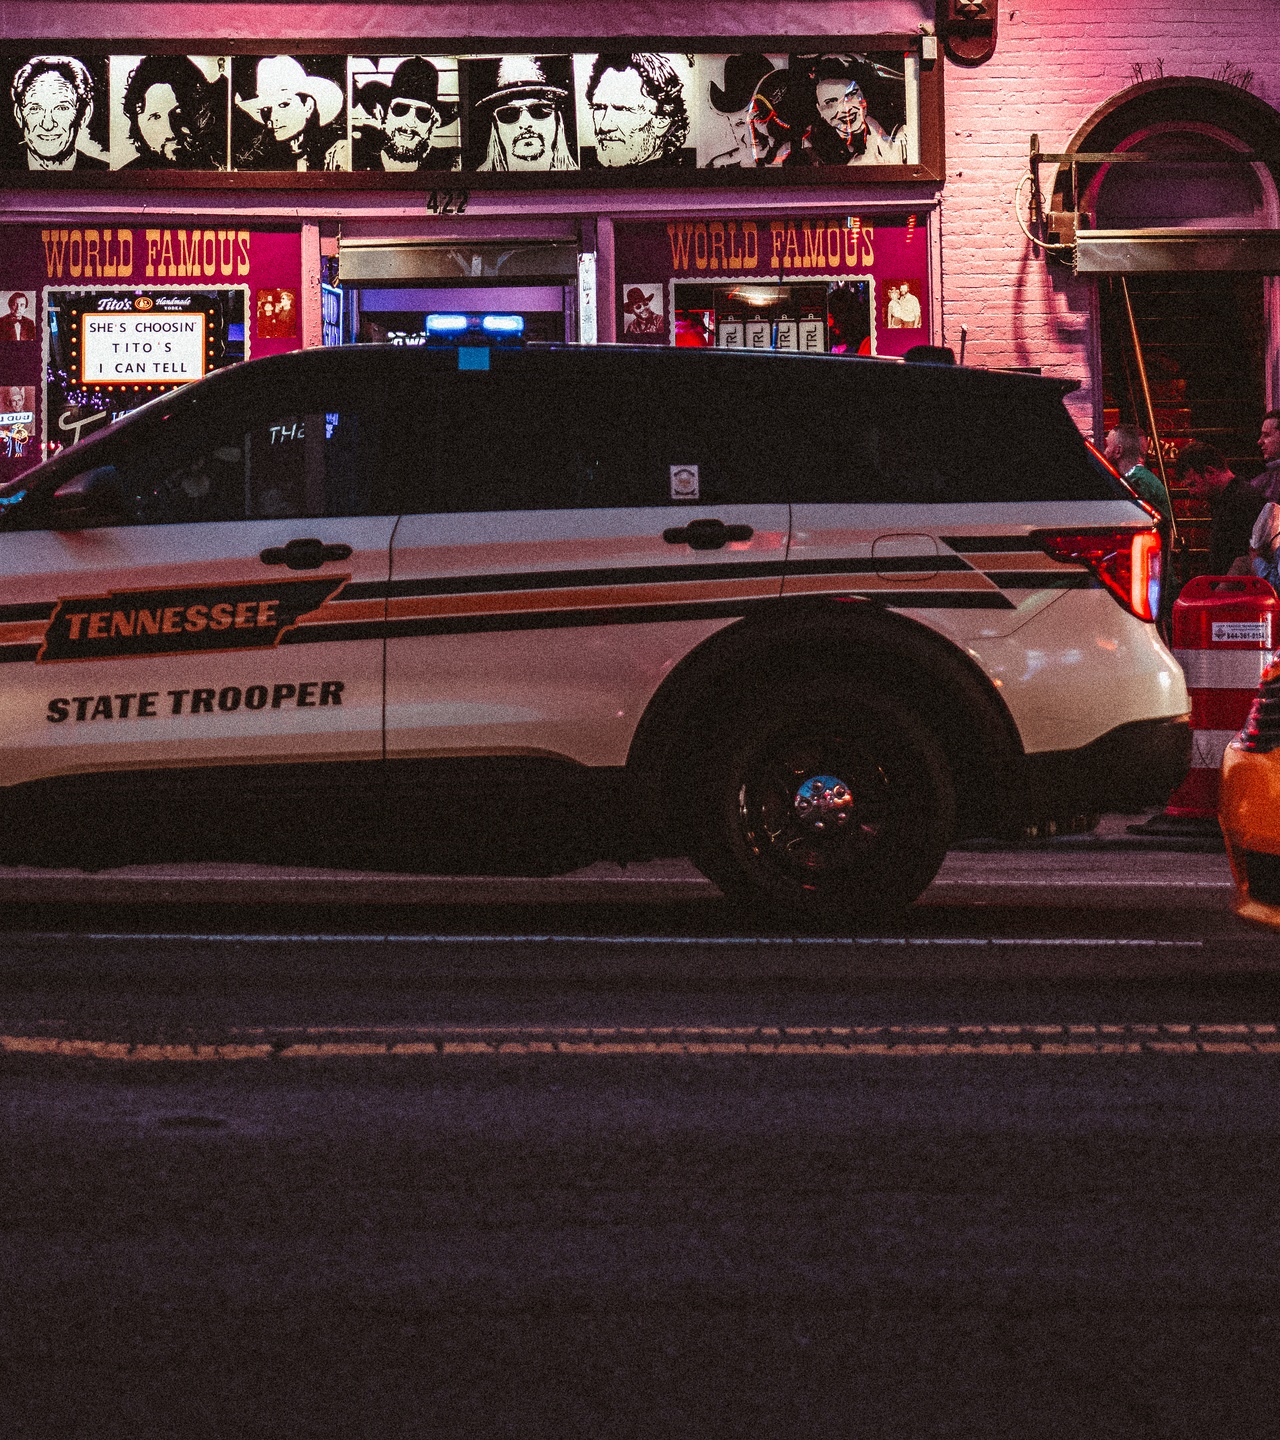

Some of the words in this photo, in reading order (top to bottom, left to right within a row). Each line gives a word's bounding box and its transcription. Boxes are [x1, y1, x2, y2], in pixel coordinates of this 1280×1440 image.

[426, 192, 469, 215] 422
[41, 229, 133, 278] WORLD
[145, 229, 251, 278] FAMOUS
[667, 221, 759, 270] WORLD
[770, 220, 875, 269] FAMOUS
[155, 297, 192, 307] Handmade
[89, 323, 127, 333] SHE'S
[99, 363, 103, 374] I
[115, 363, 146, 374] CAN
[153, 363, 188, 374] TELL
[65, 600, 281, 640] TENNESSEE
[46, 691, 160, 724] STATE
[167, 680, 346, 715] TROOPER
